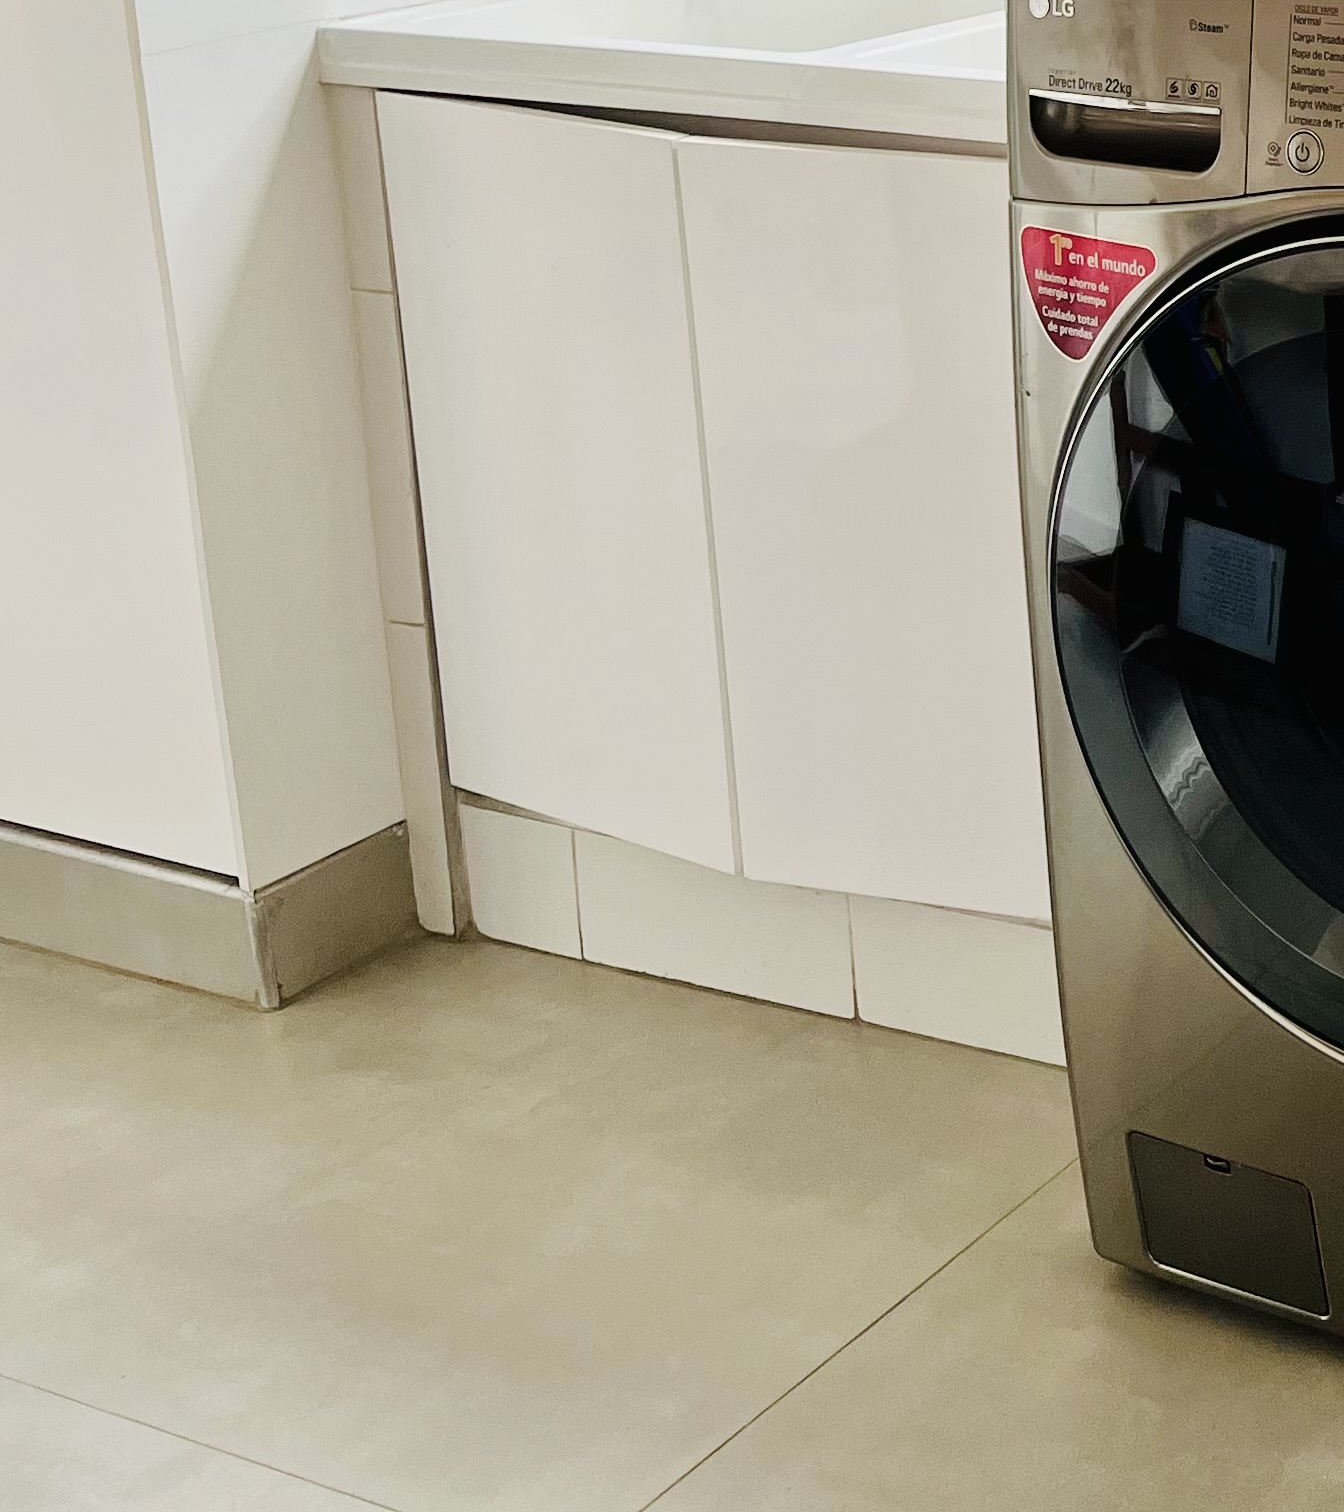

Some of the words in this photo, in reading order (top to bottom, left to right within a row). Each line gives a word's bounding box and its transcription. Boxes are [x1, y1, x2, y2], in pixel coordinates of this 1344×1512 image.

[1293, 15, 1322, 27] Normal
[1292, 32, 1315, 45] Carga
[1291, 48, 1311, 60] Ropa
[1312, 50, 1323, 61] de
[1290, 65, 1326, 77] Sanitario
[1048, 75, 1076, 89] Direct
[1078, 78, 1103, 92] Drive
[1105, 78, 1132, 98] 22kg
[1289, 98, 1314, 111] Bright
[1288, 115, 1322, 128] Limpieza
[1322, 117, 1333, 129] de
[1068, 251, 1084, 267] en
[1086, 251, 1099, 269] el
[1101, 257, 1146, 278] mundo
[1034, 268, 1068, 286] Máximo
[1068, 275, 1098, 292] ahorro
[1098, 280, 1110, 295] de
[1075, 291, 1107, 309] tiempo
[1041, 304, 1076, 323] Cuidado
[1077, 313, 1099, 328] total
[1047, 319, 1059, 333] de
[1058, 324, 1094, 340] prendas
